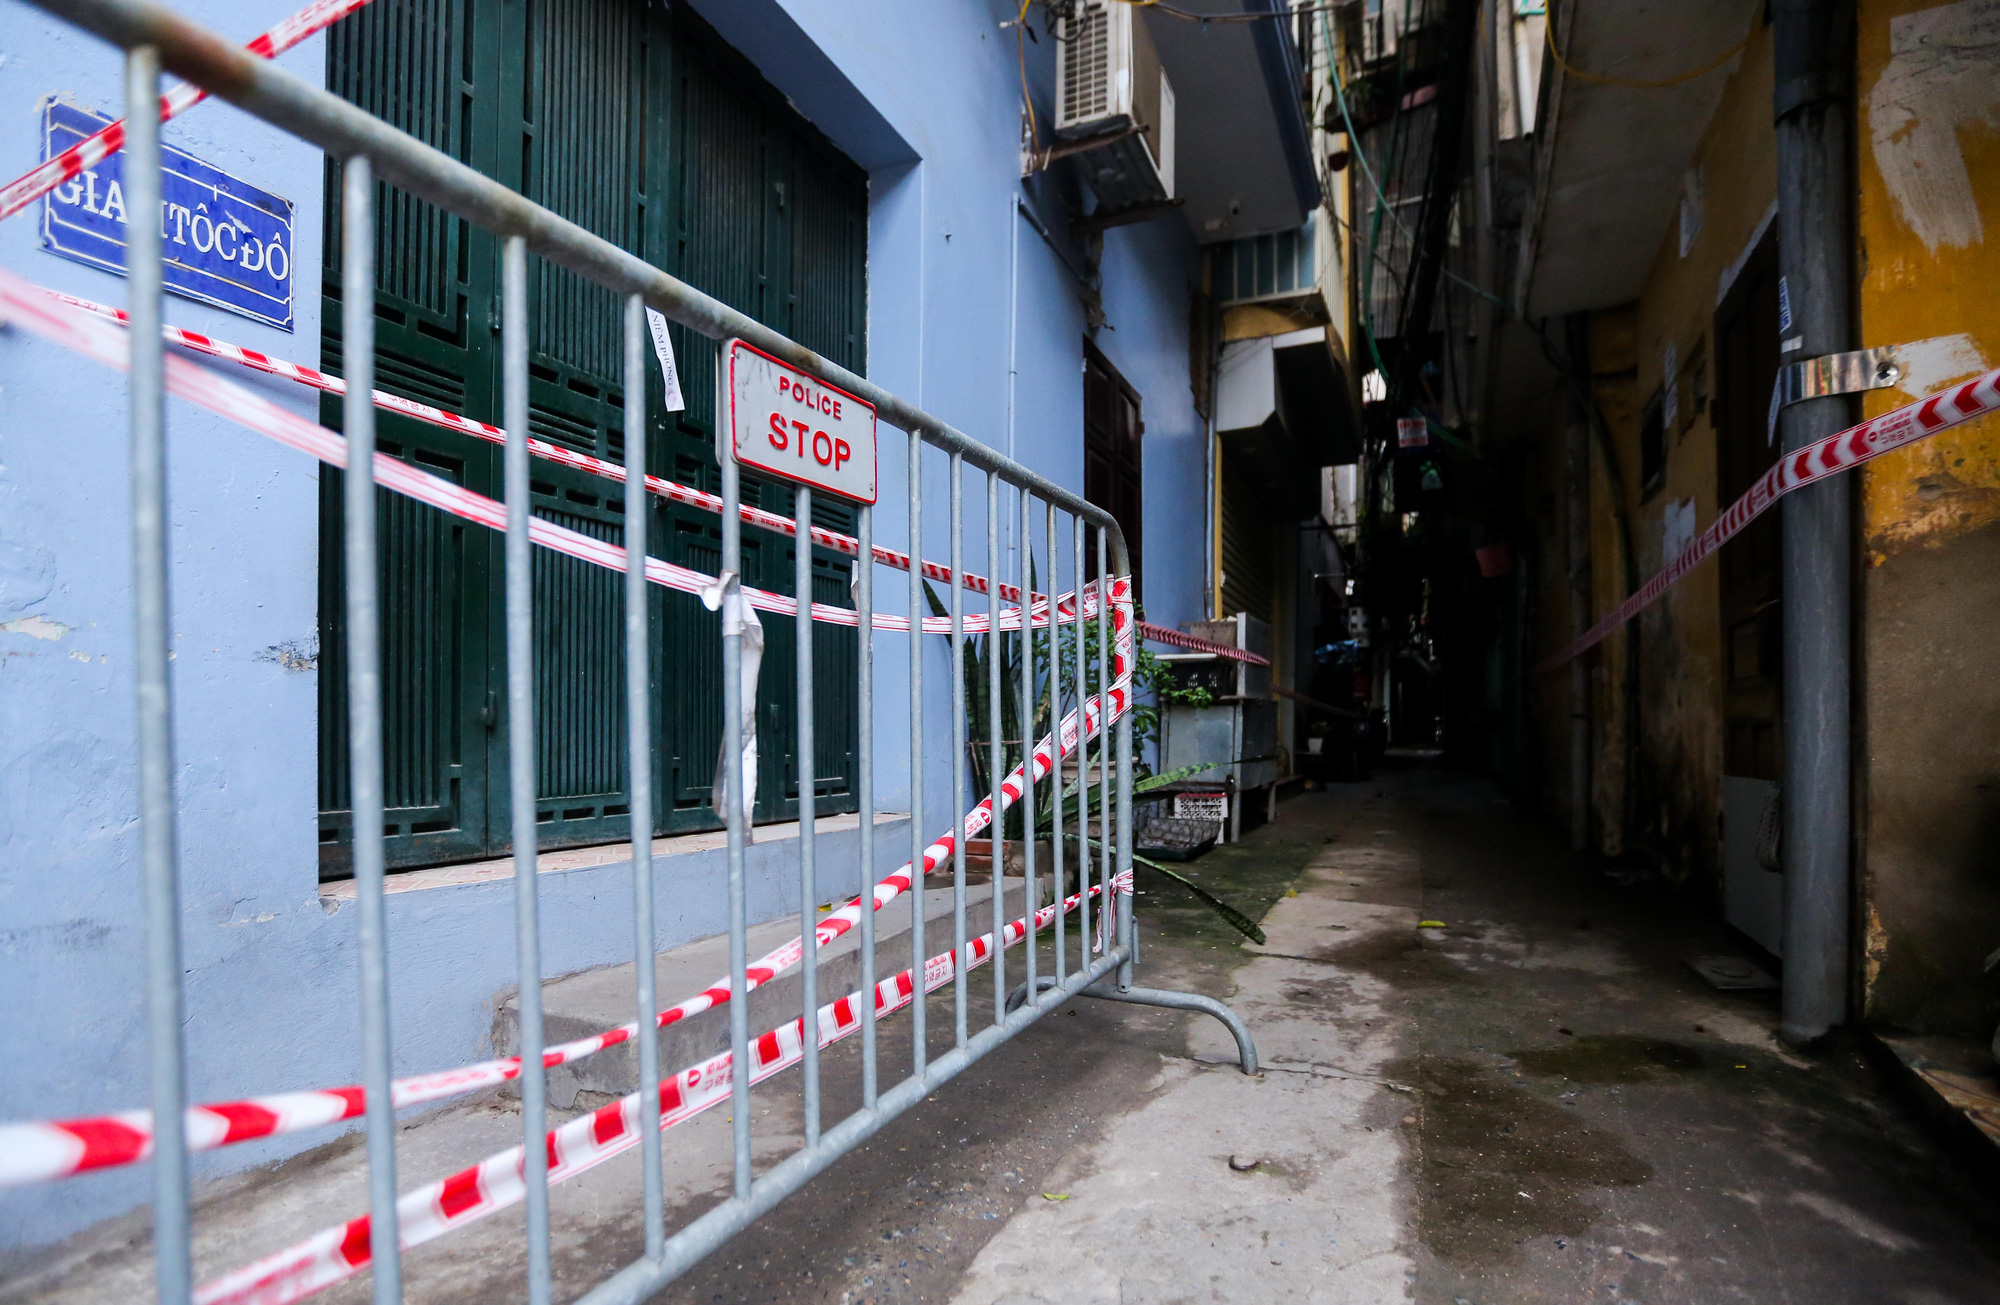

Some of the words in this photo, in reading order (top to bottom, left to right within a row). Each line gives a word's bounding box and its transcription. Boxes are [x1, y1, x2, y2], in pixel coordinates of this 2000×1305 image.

[660, 346, 674, 386] PHONG
[779, 375, 842, 420] POLICE
[768, 412, 851, 471] STOP
